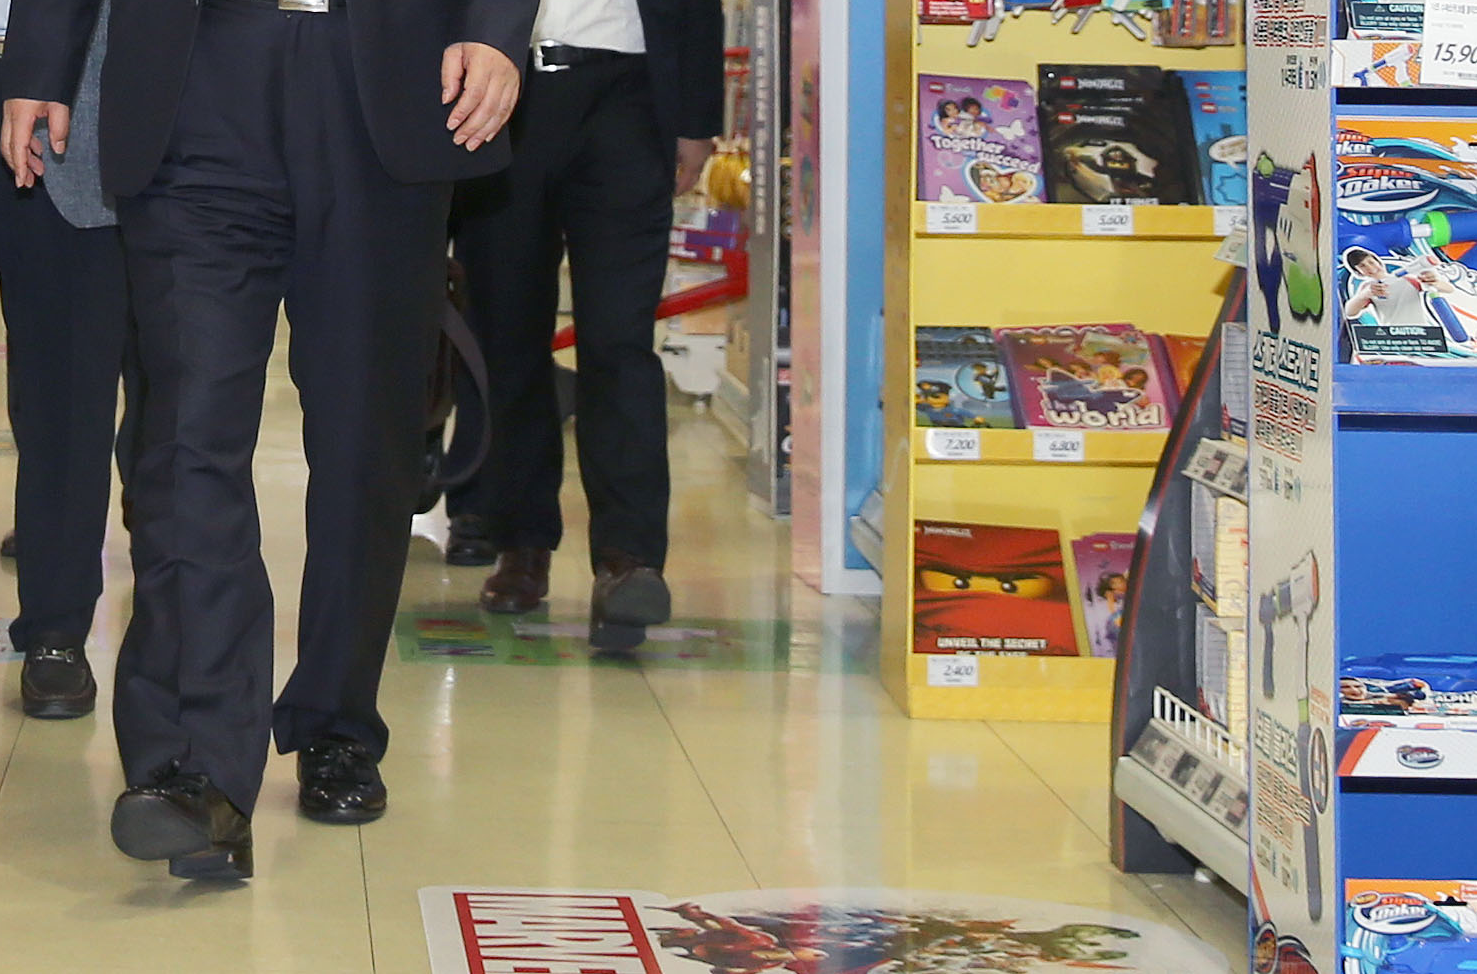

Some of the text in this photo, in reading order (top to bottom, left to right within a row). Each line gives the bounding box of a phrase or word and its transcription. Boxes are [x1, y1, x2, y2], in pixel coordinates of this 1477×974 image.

[930, 135, 1005, 155] Together
[977, 152, 1042, 173] succeed
[1050, 404, 1161, 427] world
